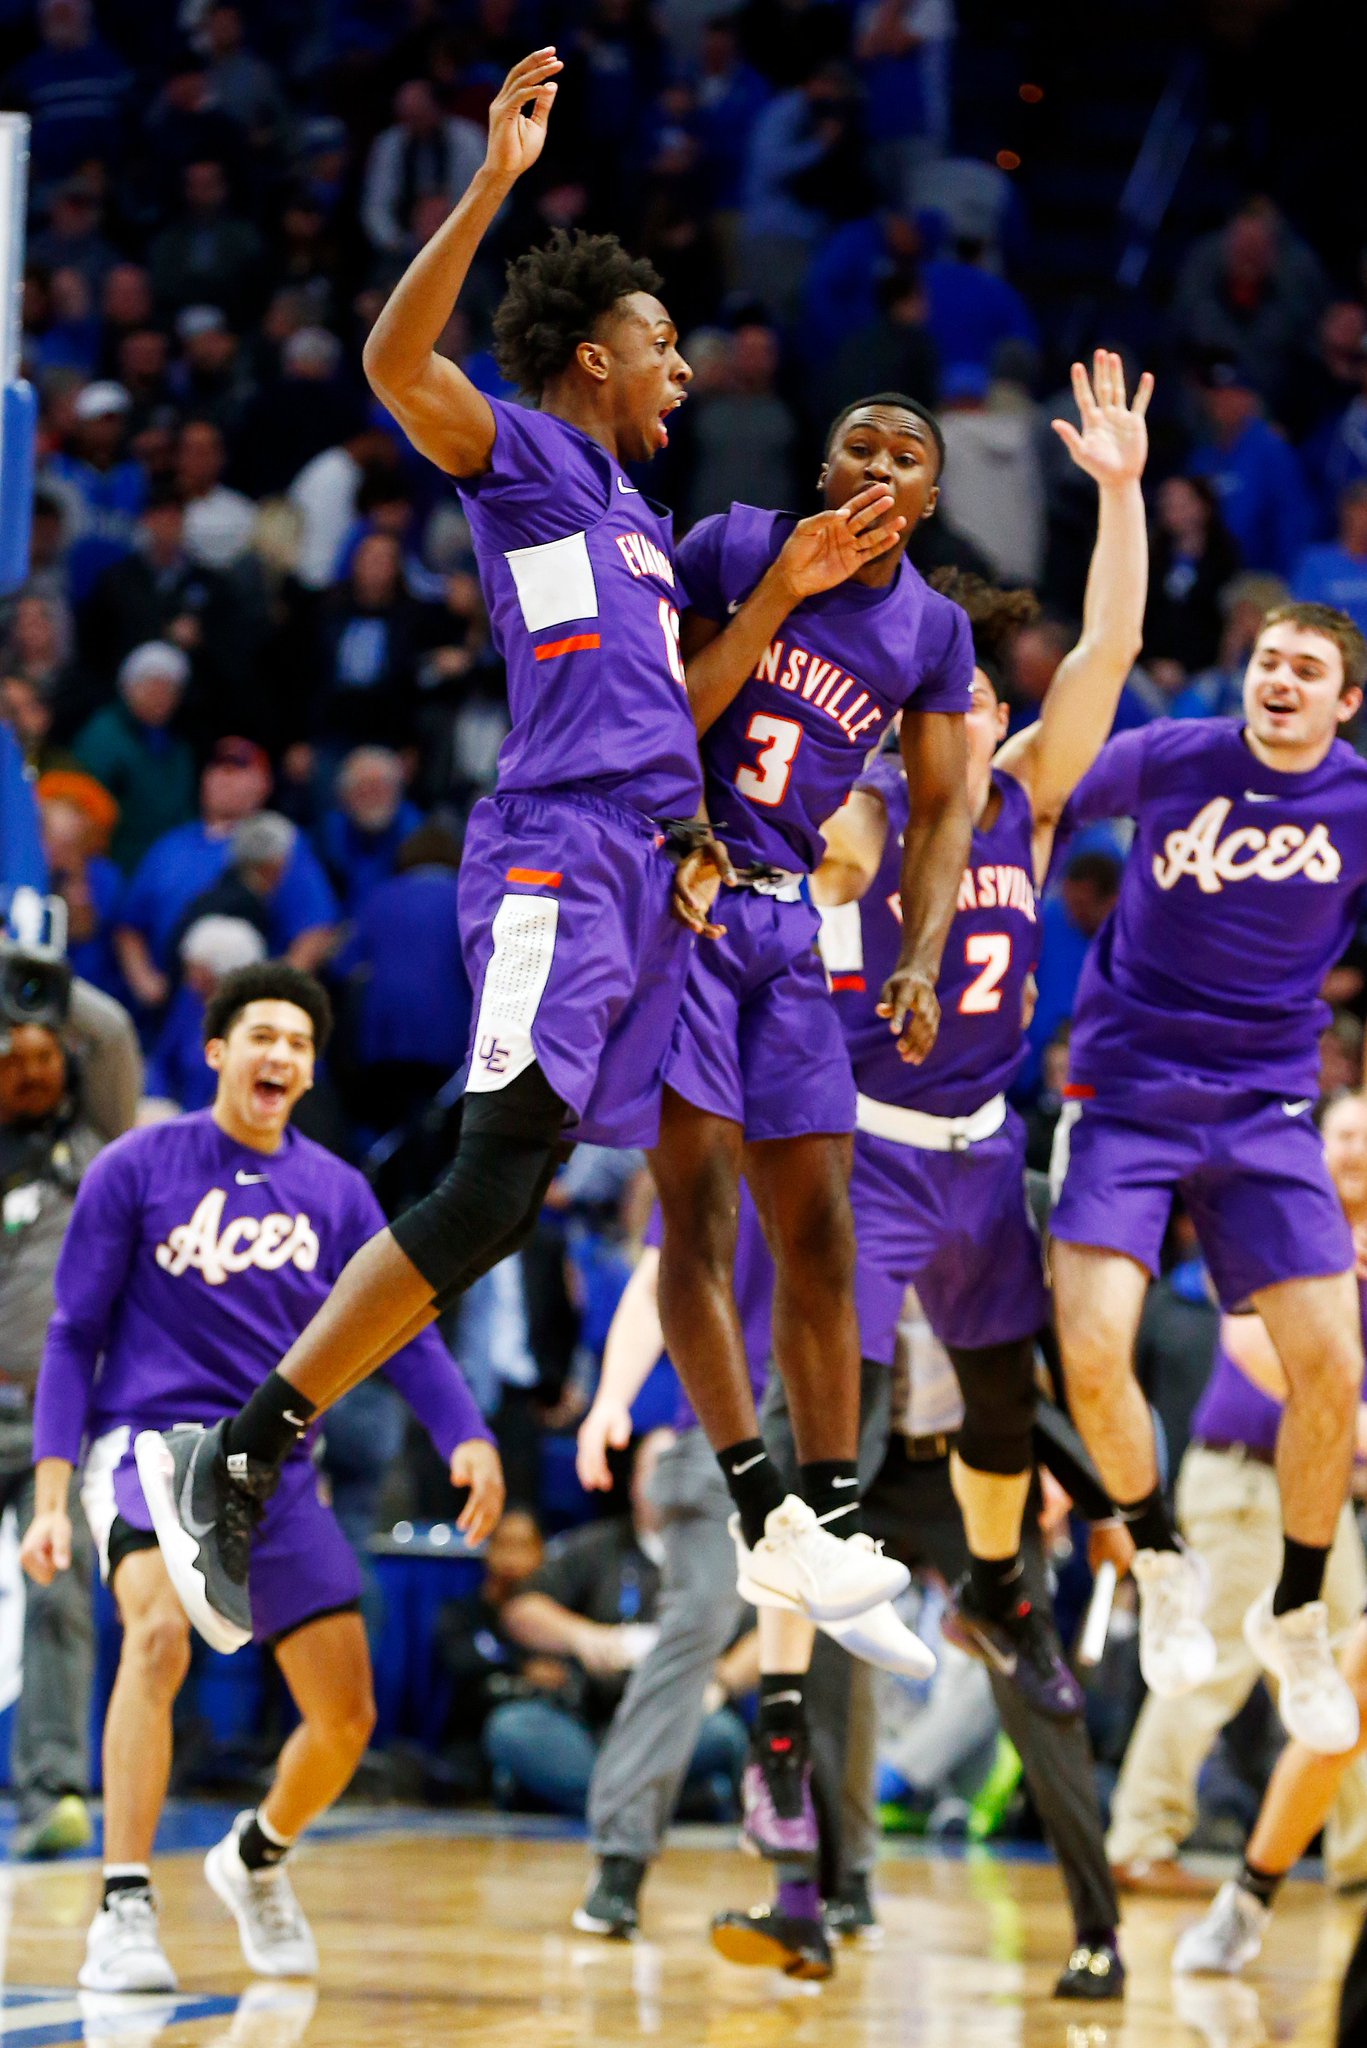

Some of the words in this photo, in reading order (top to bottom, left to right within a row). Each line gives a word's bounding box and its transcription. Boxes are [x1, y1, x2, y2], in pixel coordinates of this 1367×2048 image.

[755, 639, 883, 744] NSVILLE
[735, 711, 804, 807] 3
[958, 932, 1012, 1016] 2
[478, 1034, 511, 1075] UE
